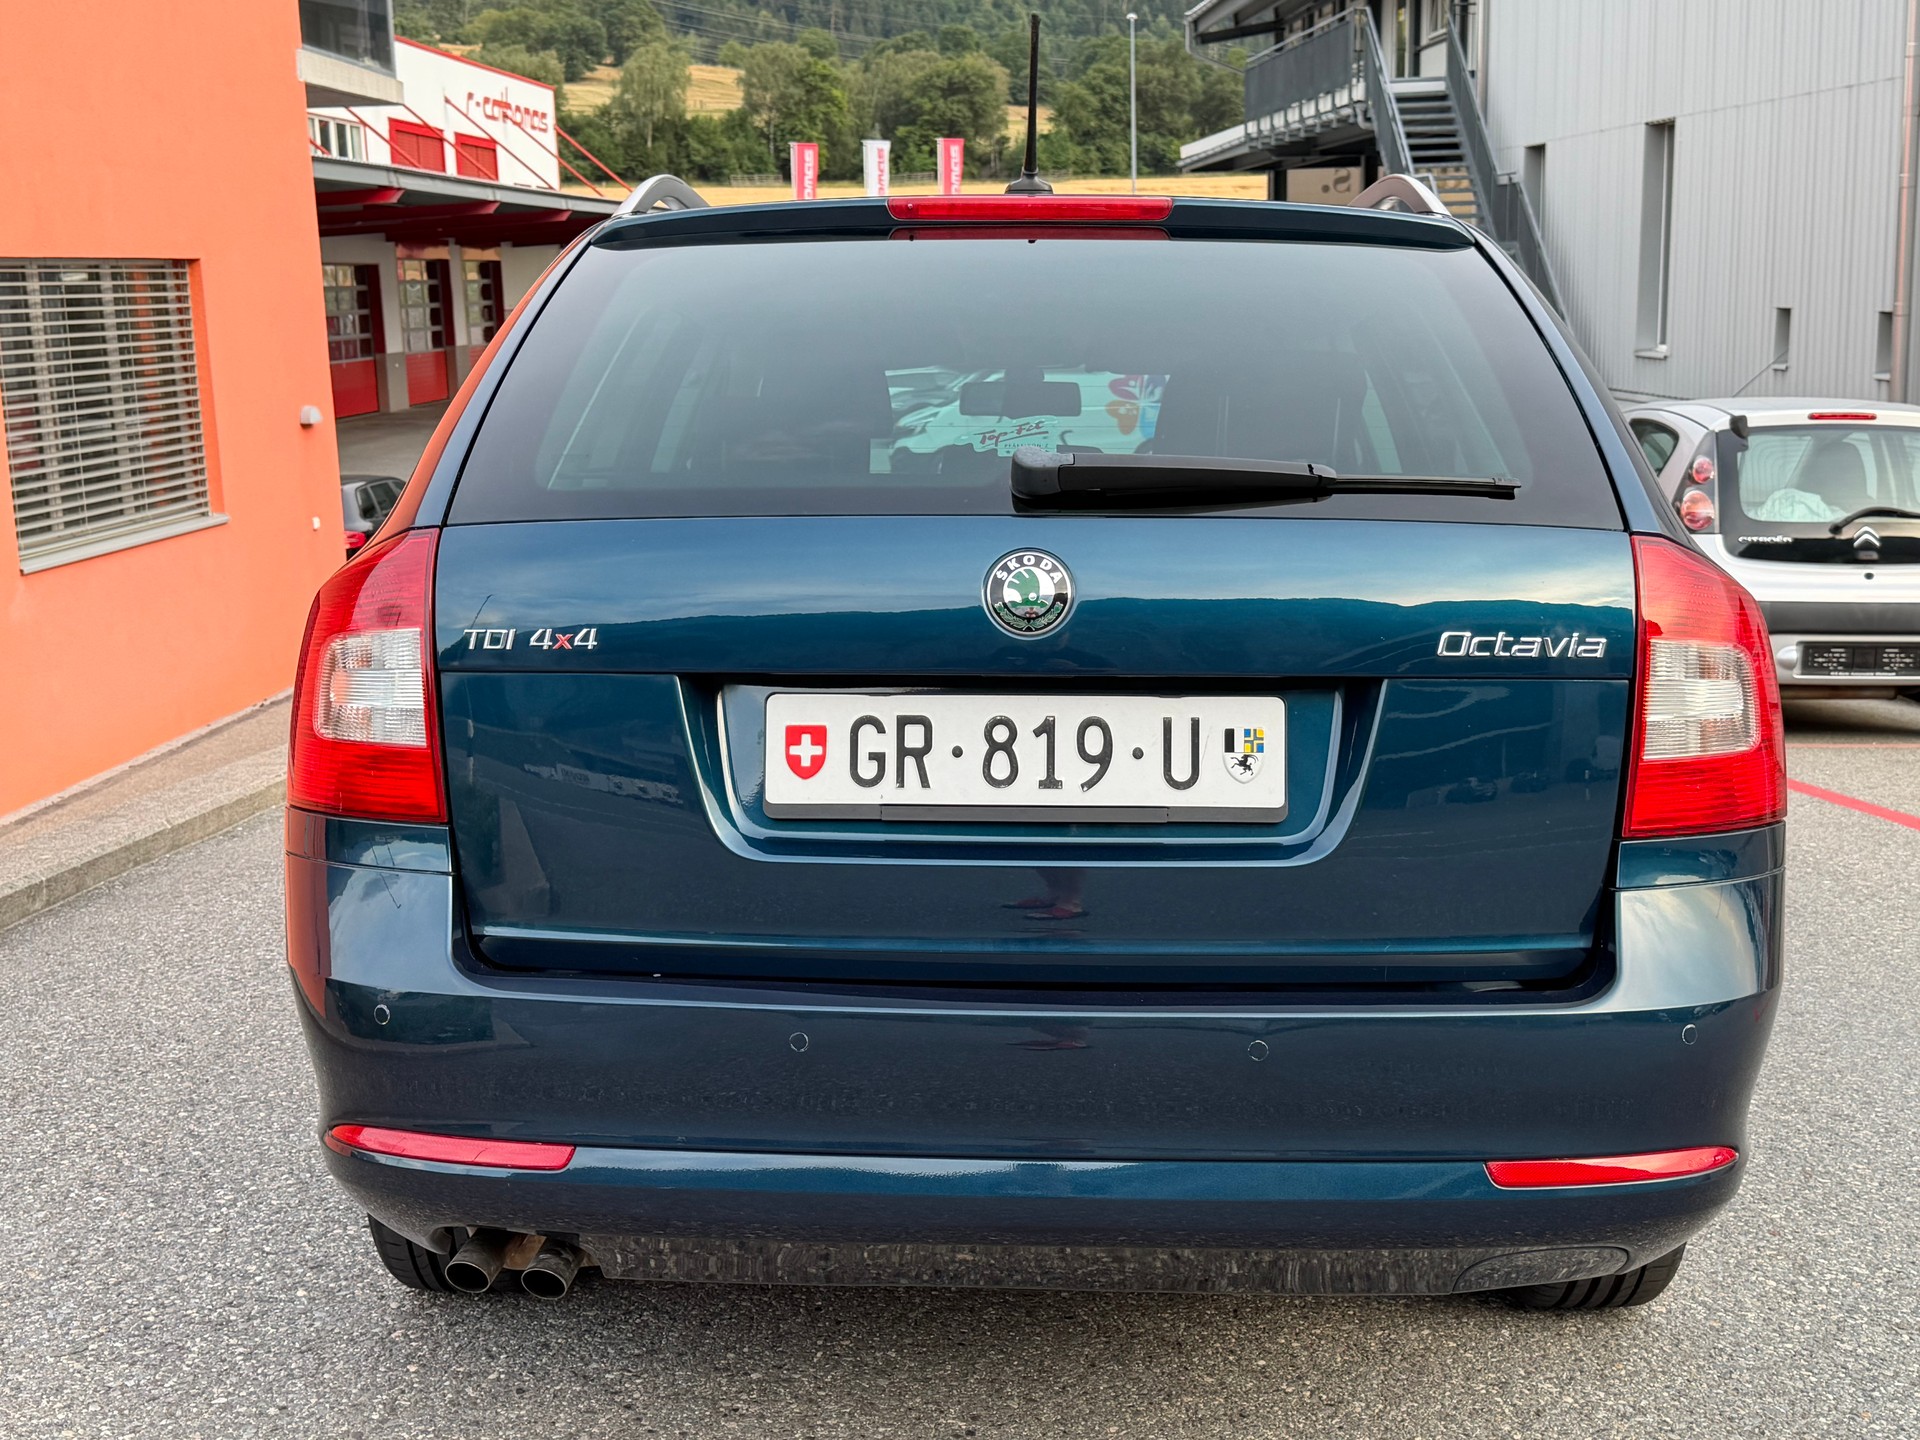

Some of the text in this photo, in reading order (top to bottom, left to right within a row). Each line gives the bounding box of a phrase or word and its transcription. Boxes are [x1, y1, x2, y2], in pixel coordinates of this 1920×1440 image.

[463, 628, 598, 650] TDI 4x4
[1436, 631, 1607, 658] Octavia
